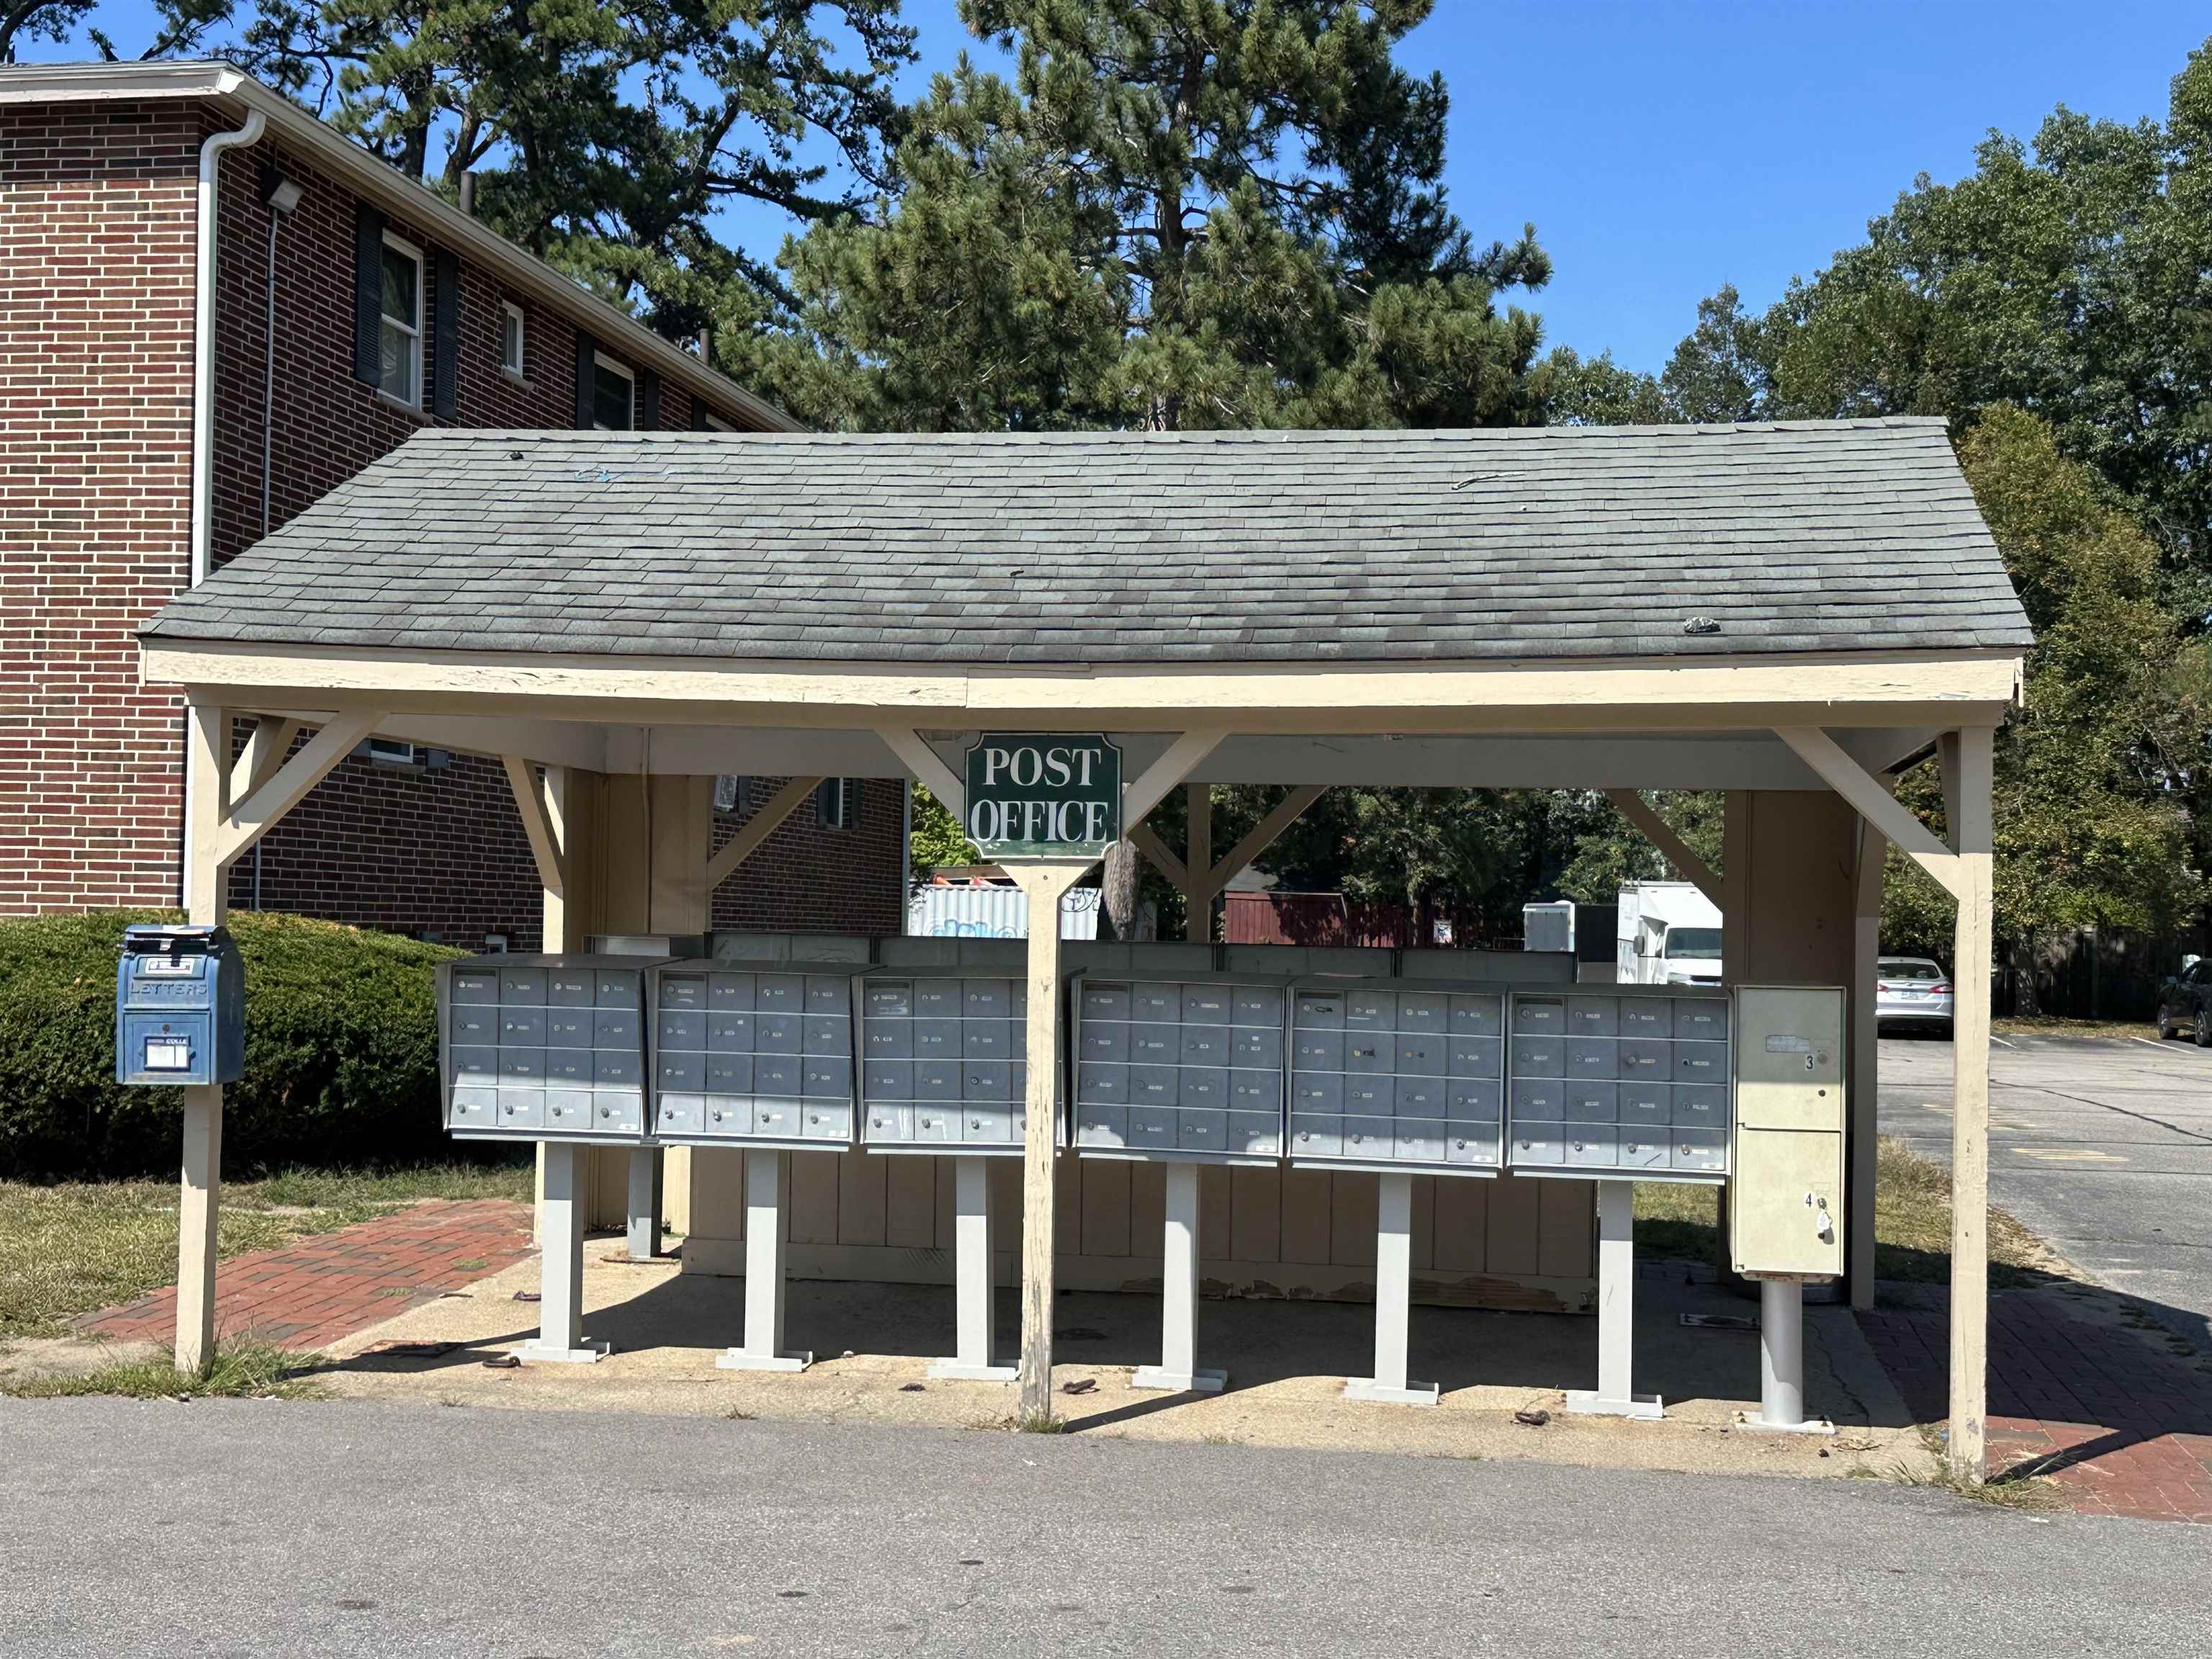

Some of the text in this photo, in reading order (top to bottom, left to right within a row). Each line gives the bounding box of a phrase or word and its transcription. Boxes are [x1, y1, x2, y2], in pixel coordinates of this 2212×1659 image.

[981, 747, 1102, 787] POST
[971, 799, 1108, 843] OFFICE
[130, 981, 207, 995] LETTERS
[1806, 1055, 1814, 1069] 3
[1805, 1193, 1812, 1208] 4
